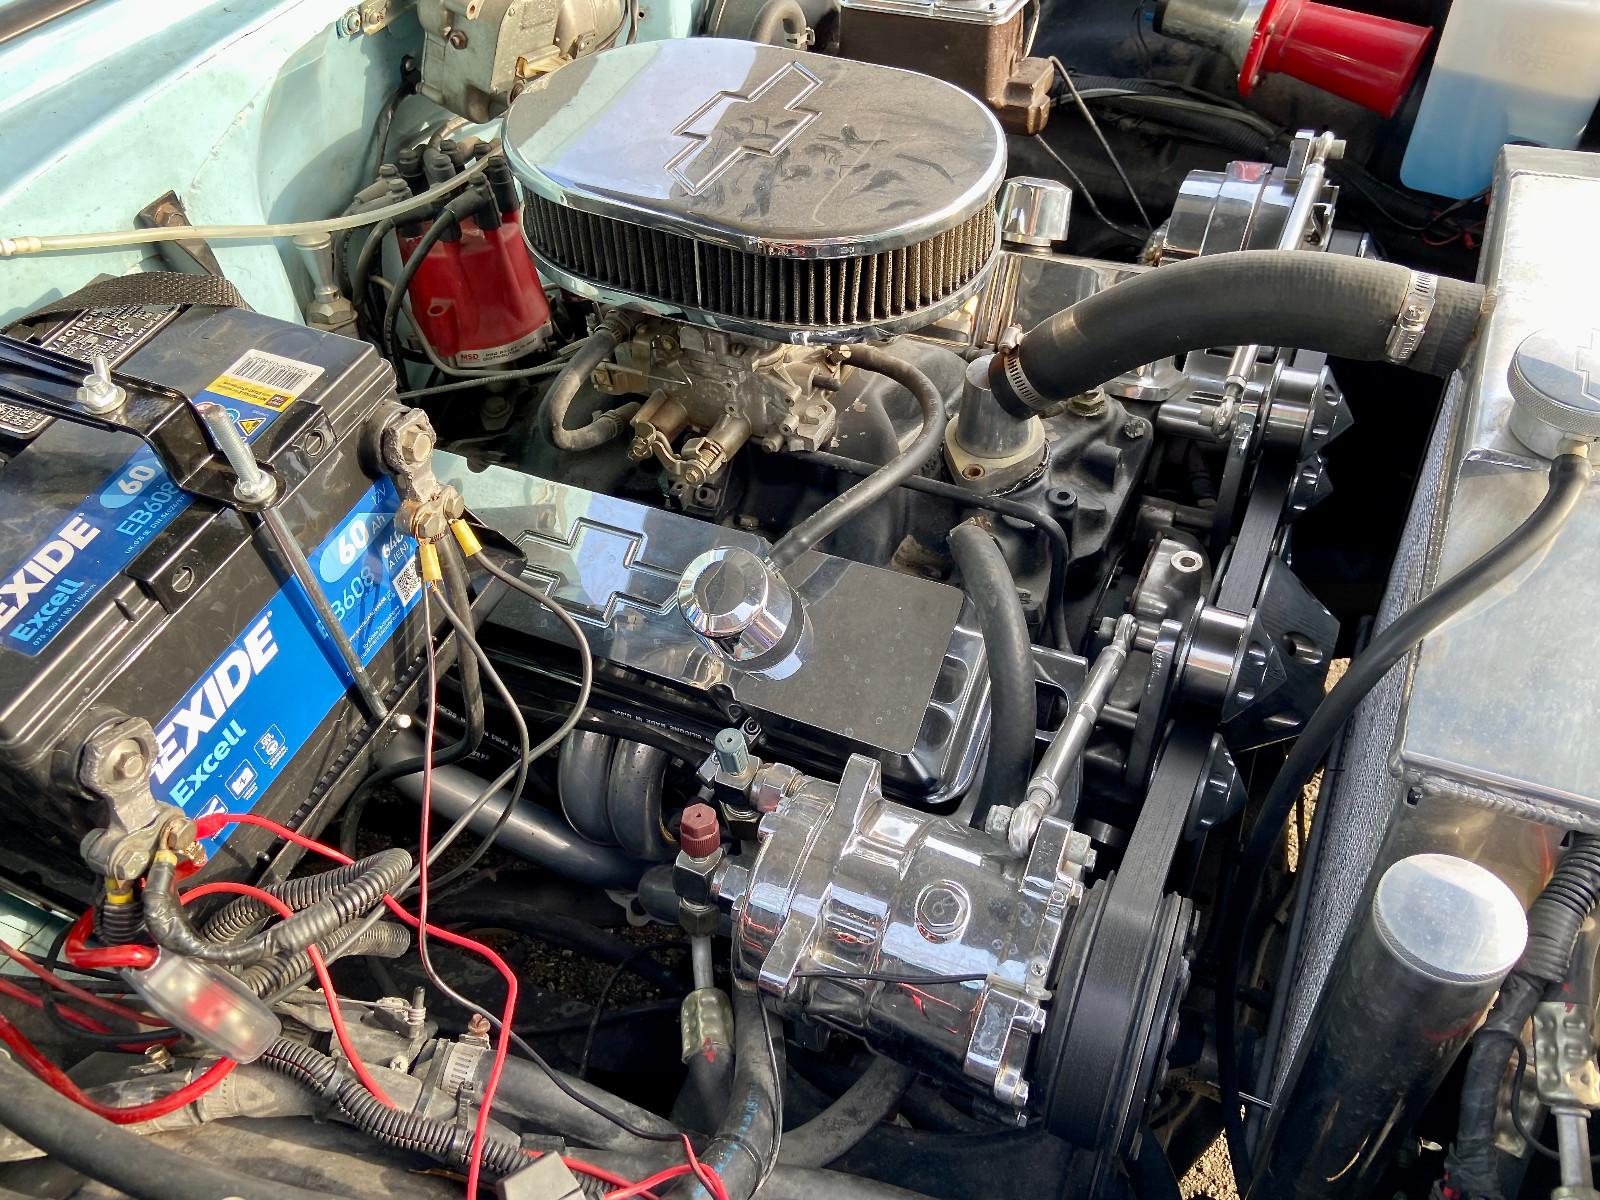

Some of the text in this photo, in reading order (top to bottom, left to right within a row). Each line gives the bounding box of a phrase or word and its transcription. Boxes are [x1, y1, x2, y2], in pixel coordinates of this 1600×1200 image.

[461, 353, 479, 361] MSD
[118, 465, 156, 494] 60
[371, 483, 386, 505] 12V
[338, 514, 386, 565] 60 Ah
[0, 515, 101, 630] EXIDE
[9, 578, 85, 642] Excell
[154, 614, 279, 785] EXIDE
[168, 717, 248, 808] Excell
